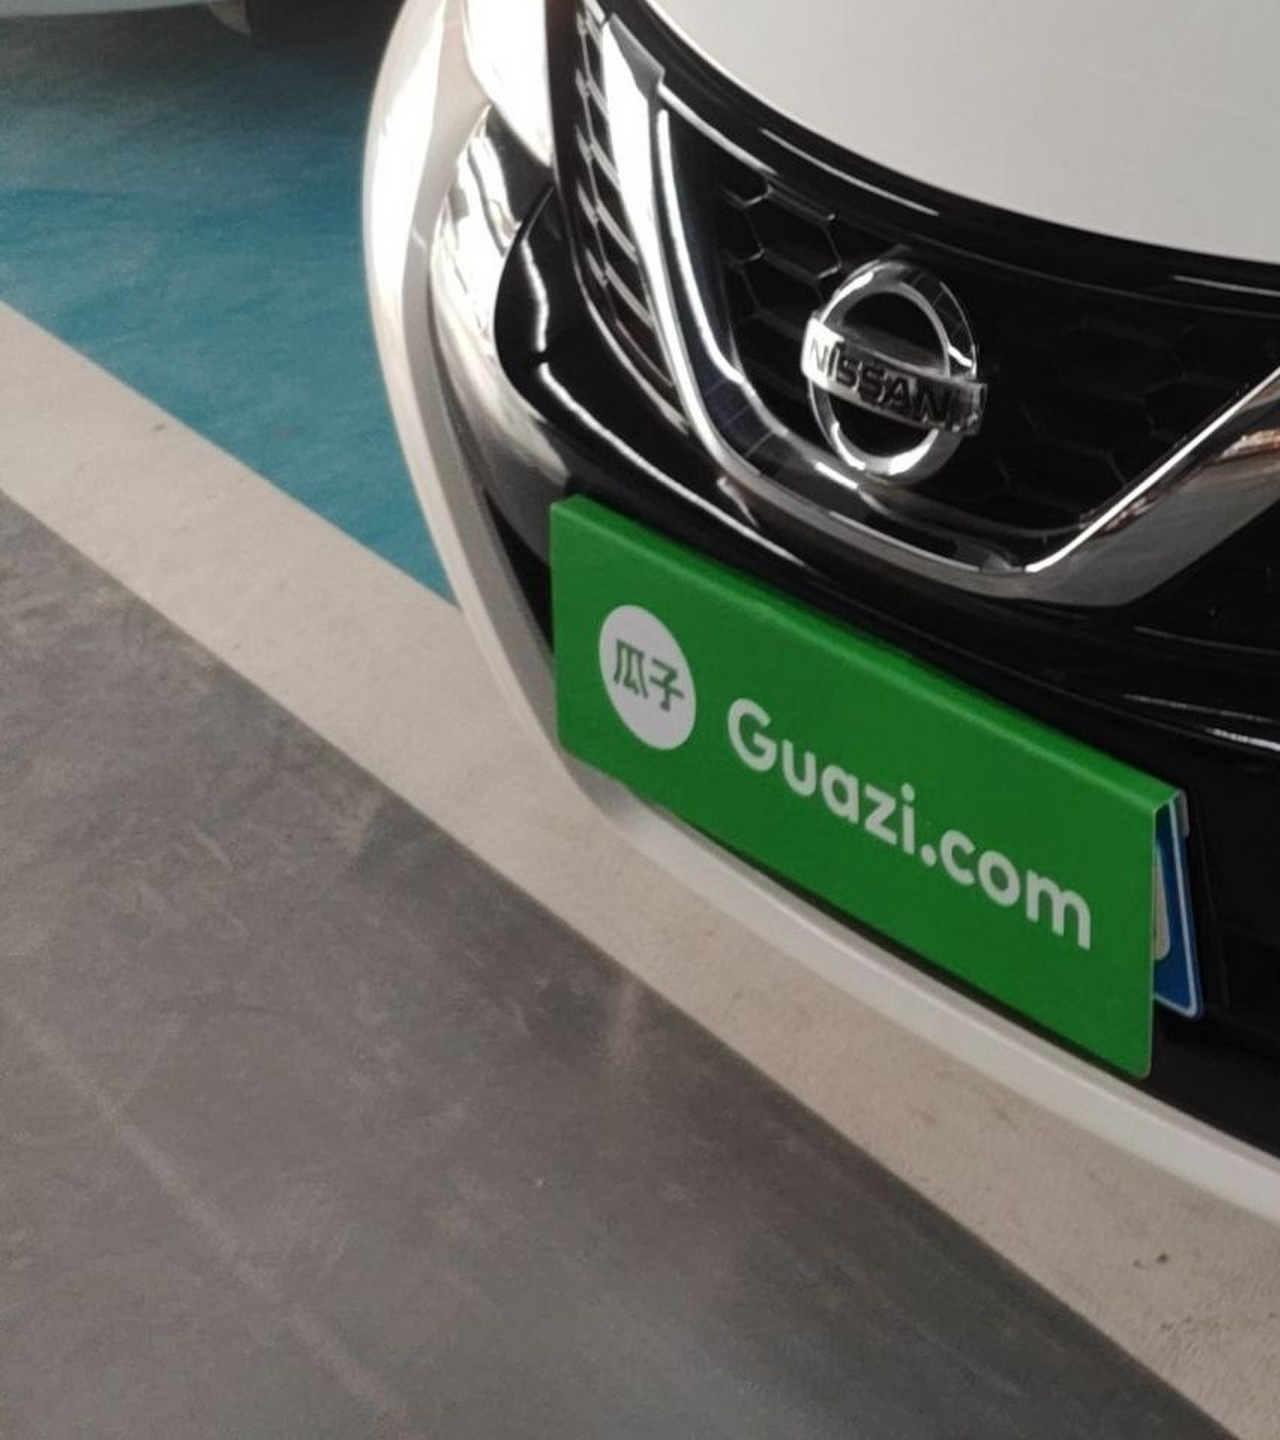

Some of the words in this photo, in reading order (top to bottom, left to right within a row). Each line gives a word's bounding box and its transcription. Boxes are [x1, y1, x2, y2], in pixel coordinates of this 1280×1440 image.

[811, 335, 950, 430] NISSAN
[613, 638, 685, 712] 瓜子
[727, 697, 1092, 950] Guazi.com
